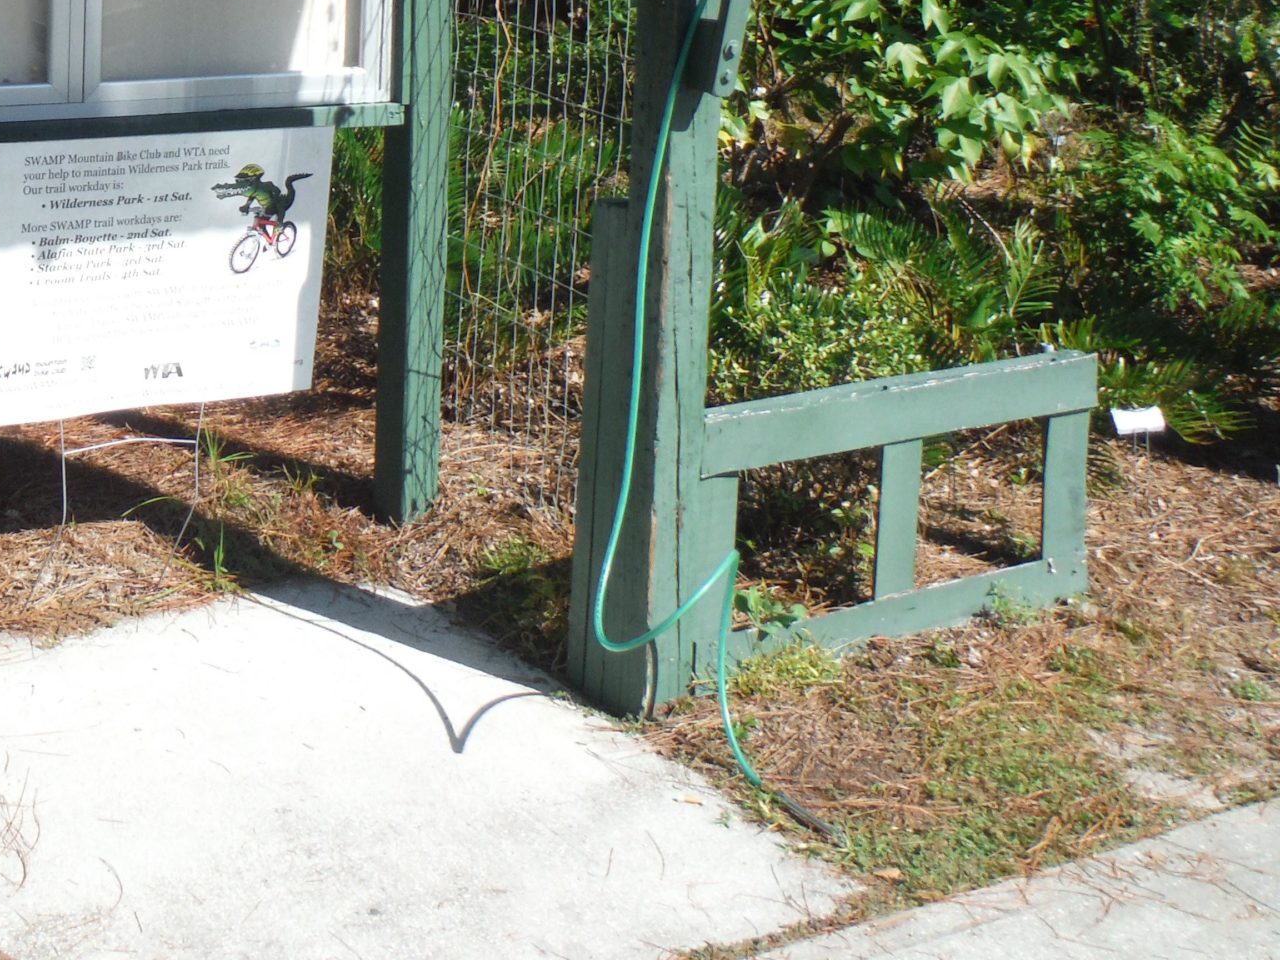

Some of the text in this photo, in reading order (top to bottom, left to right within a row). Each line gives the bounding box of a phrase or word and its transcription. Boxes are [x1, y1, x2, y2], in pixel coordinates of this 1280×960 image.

[24, 145, 230, 167] SWAMP Mountain Bike Club and WTA need
[23, 159, 231, 184] your help to maintain Wilderness Park trails.
[23, 180, 124, 195] Our trail workday is:
[49, 197, 114, 210] Wilderness
[116, 193, 145, 206] Park
[153, 192, 169, 203] 1st
[170, 191, 193, 202] Sat.
[21, 213, 183, 234] More SWAMP trail workdays are:
[39, 233, 118, 248] Balm-Boyette
[126, 228, 148, 240] 2nd
[149, 227, 173, 238] Sat.
[37, 248, 73, 261] Alafia
[77, 246, 108, 257] State
[109, 242, 136, 255] Park
[86, 257, 113, 270] Park
